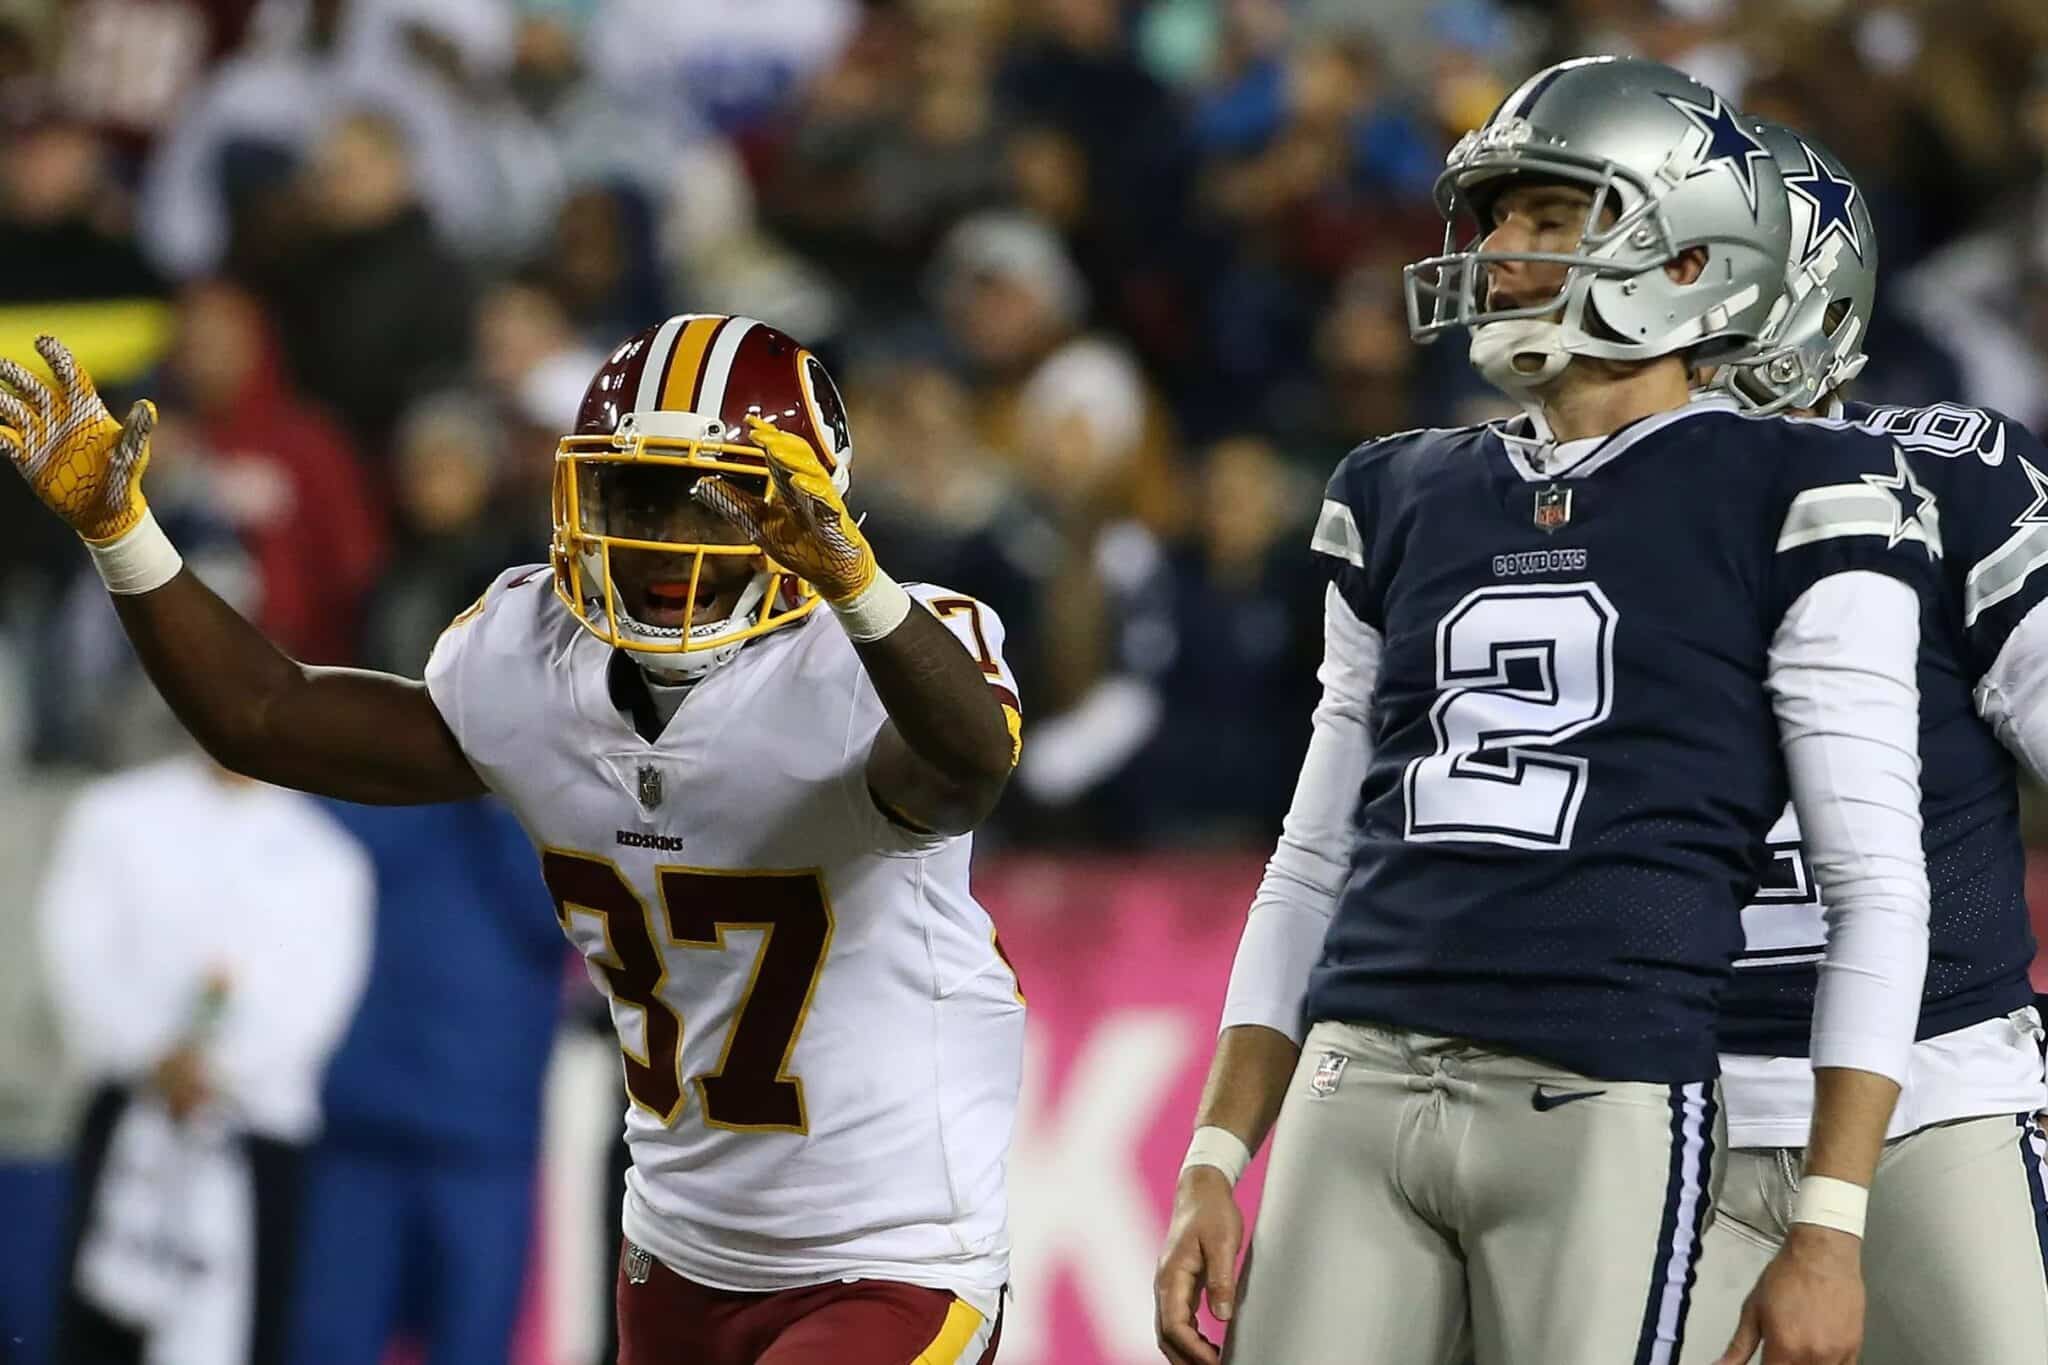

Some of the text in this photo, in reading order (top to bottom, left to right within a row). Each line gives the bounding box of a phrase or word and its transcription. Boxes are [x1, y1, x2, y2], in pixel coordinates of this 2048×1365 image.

[1493, 548, 1587, 576] COWBOYS
[1404, 580, 1620, 851] 2
[616, 830, 684, 851] REDSKINS
[540, 846, 834, 1137] 37
